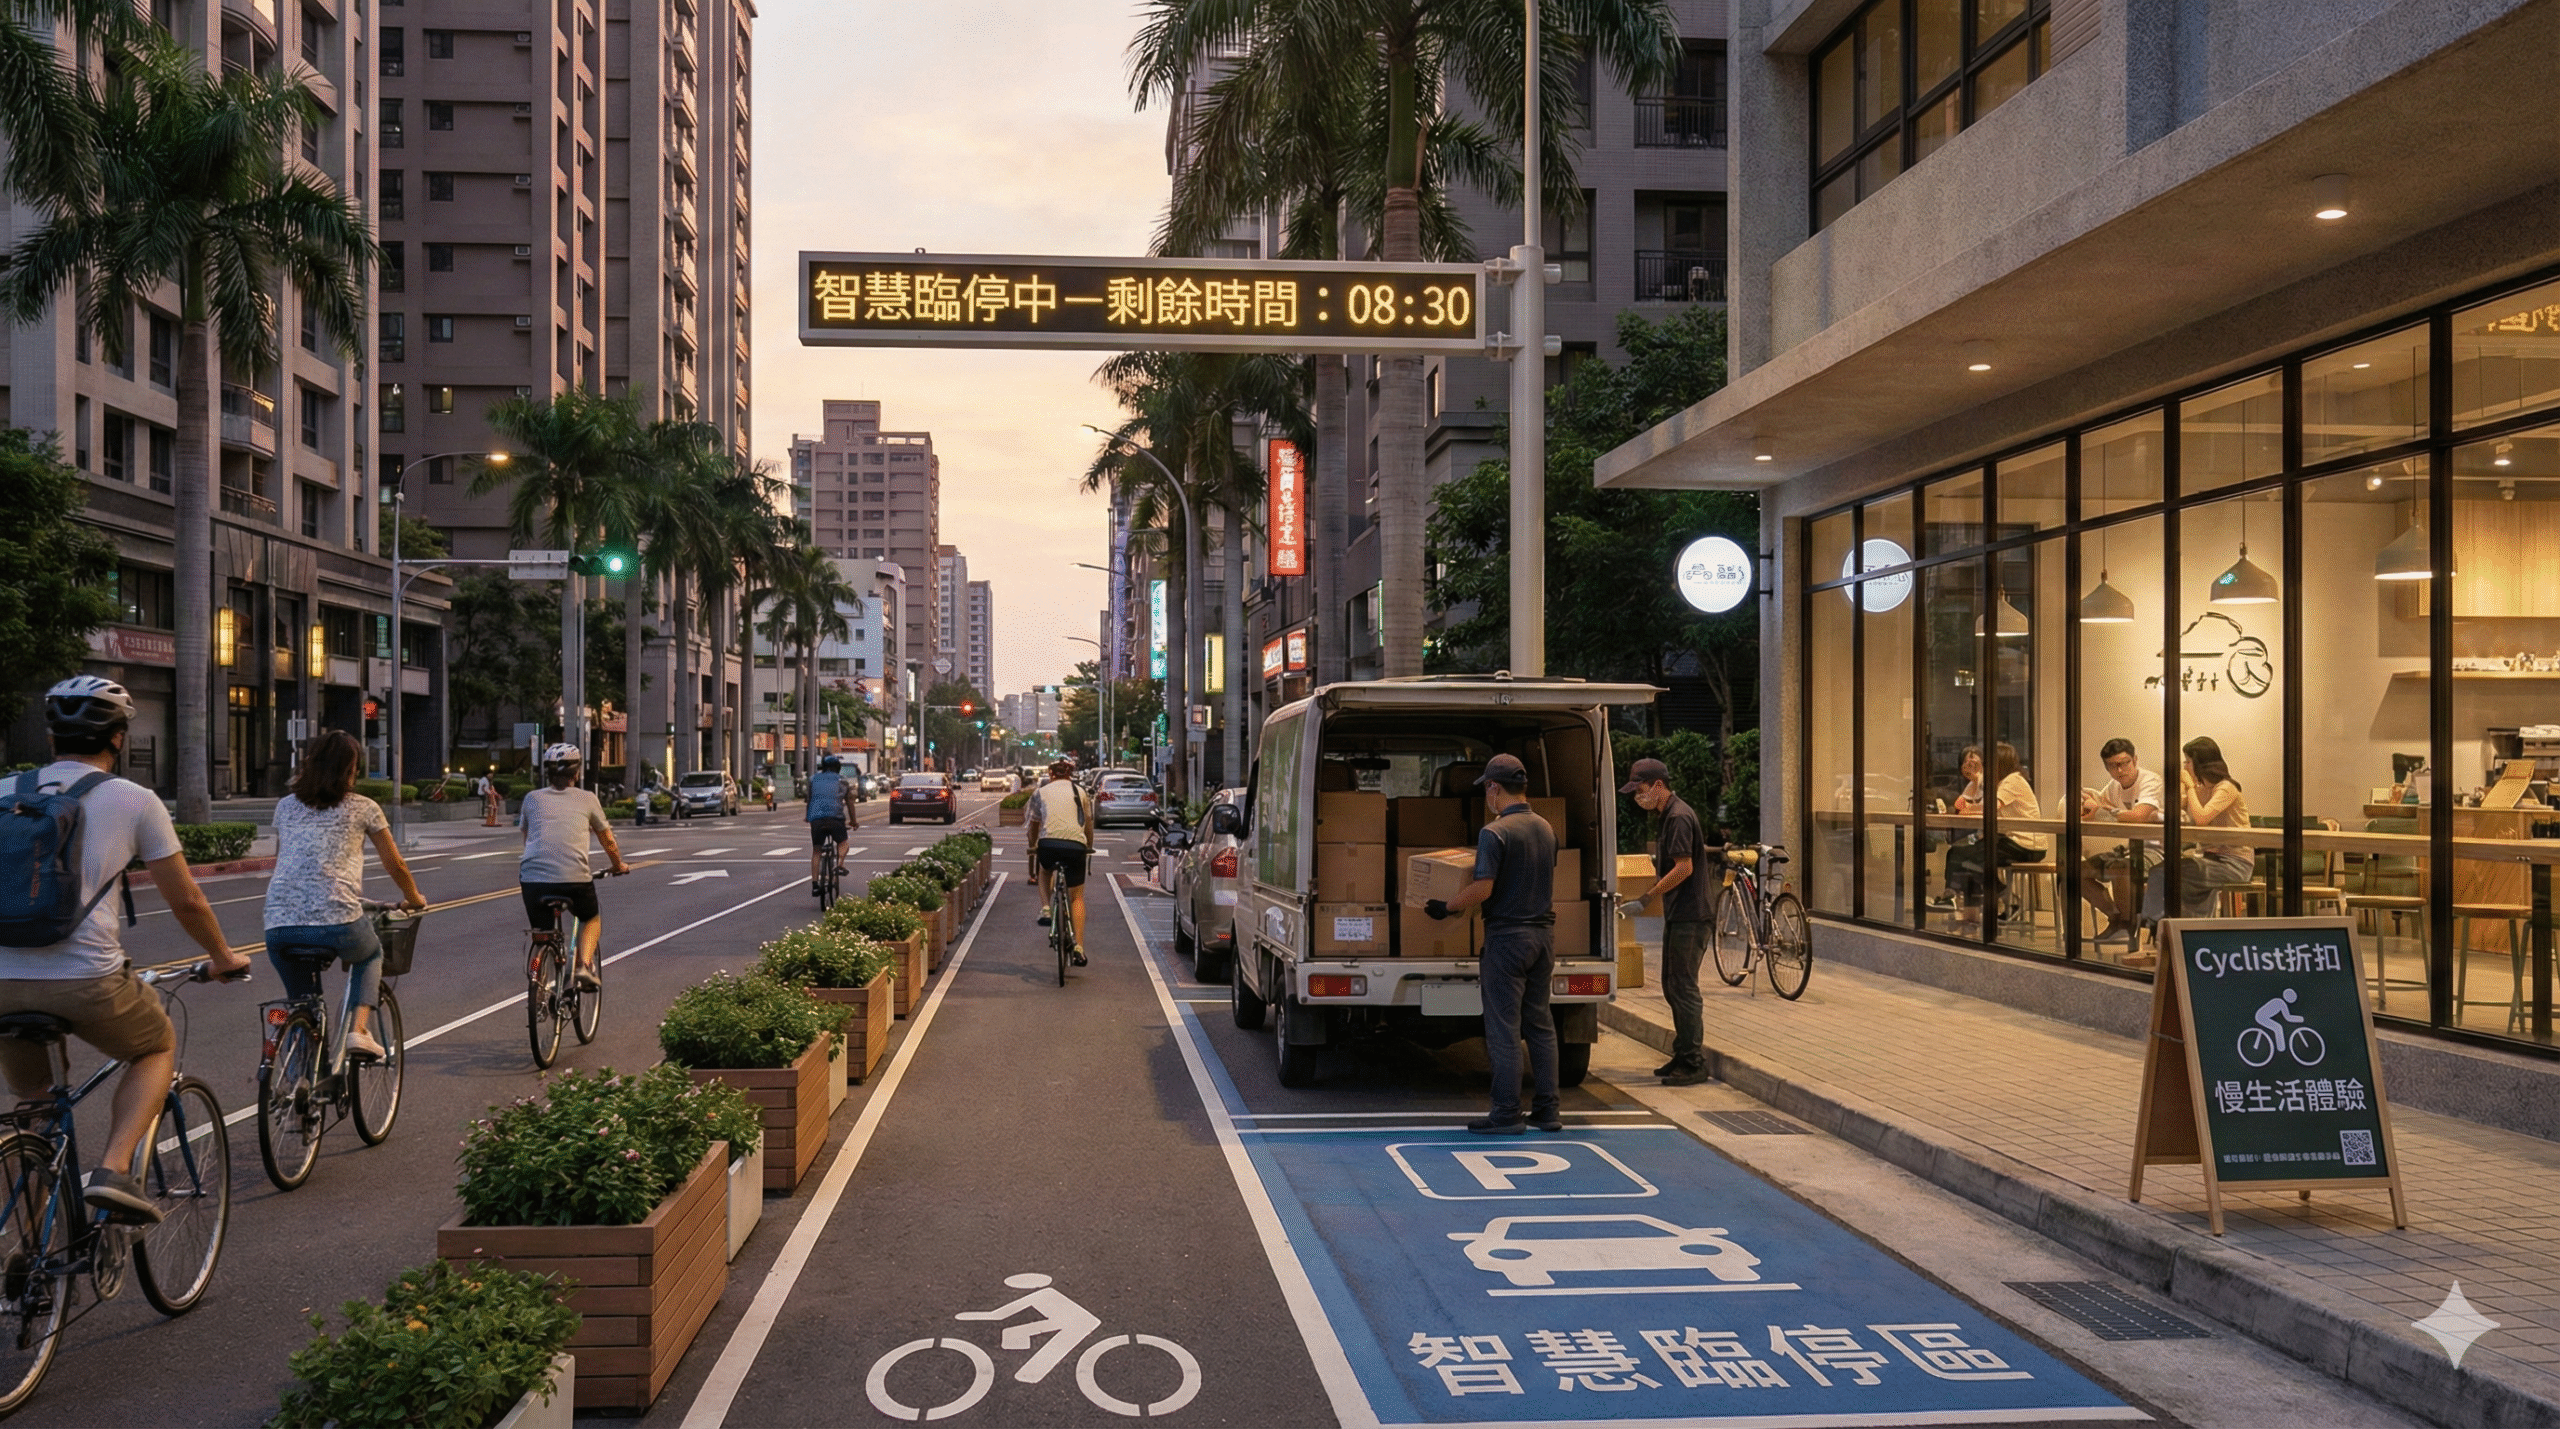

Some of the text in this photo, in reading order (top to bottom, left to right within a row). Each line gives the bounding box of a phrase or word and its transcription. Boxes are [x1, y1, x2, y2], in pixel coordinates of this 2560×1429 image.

[2195, 943, 2340, 978] Cyclist折扣
[2215, 1077, 2367, 1114] 慢生活體驗
[1451, 1150, 1571, 1190] P
[1407, 1322, 2035, 1397] 智慧臨停區
